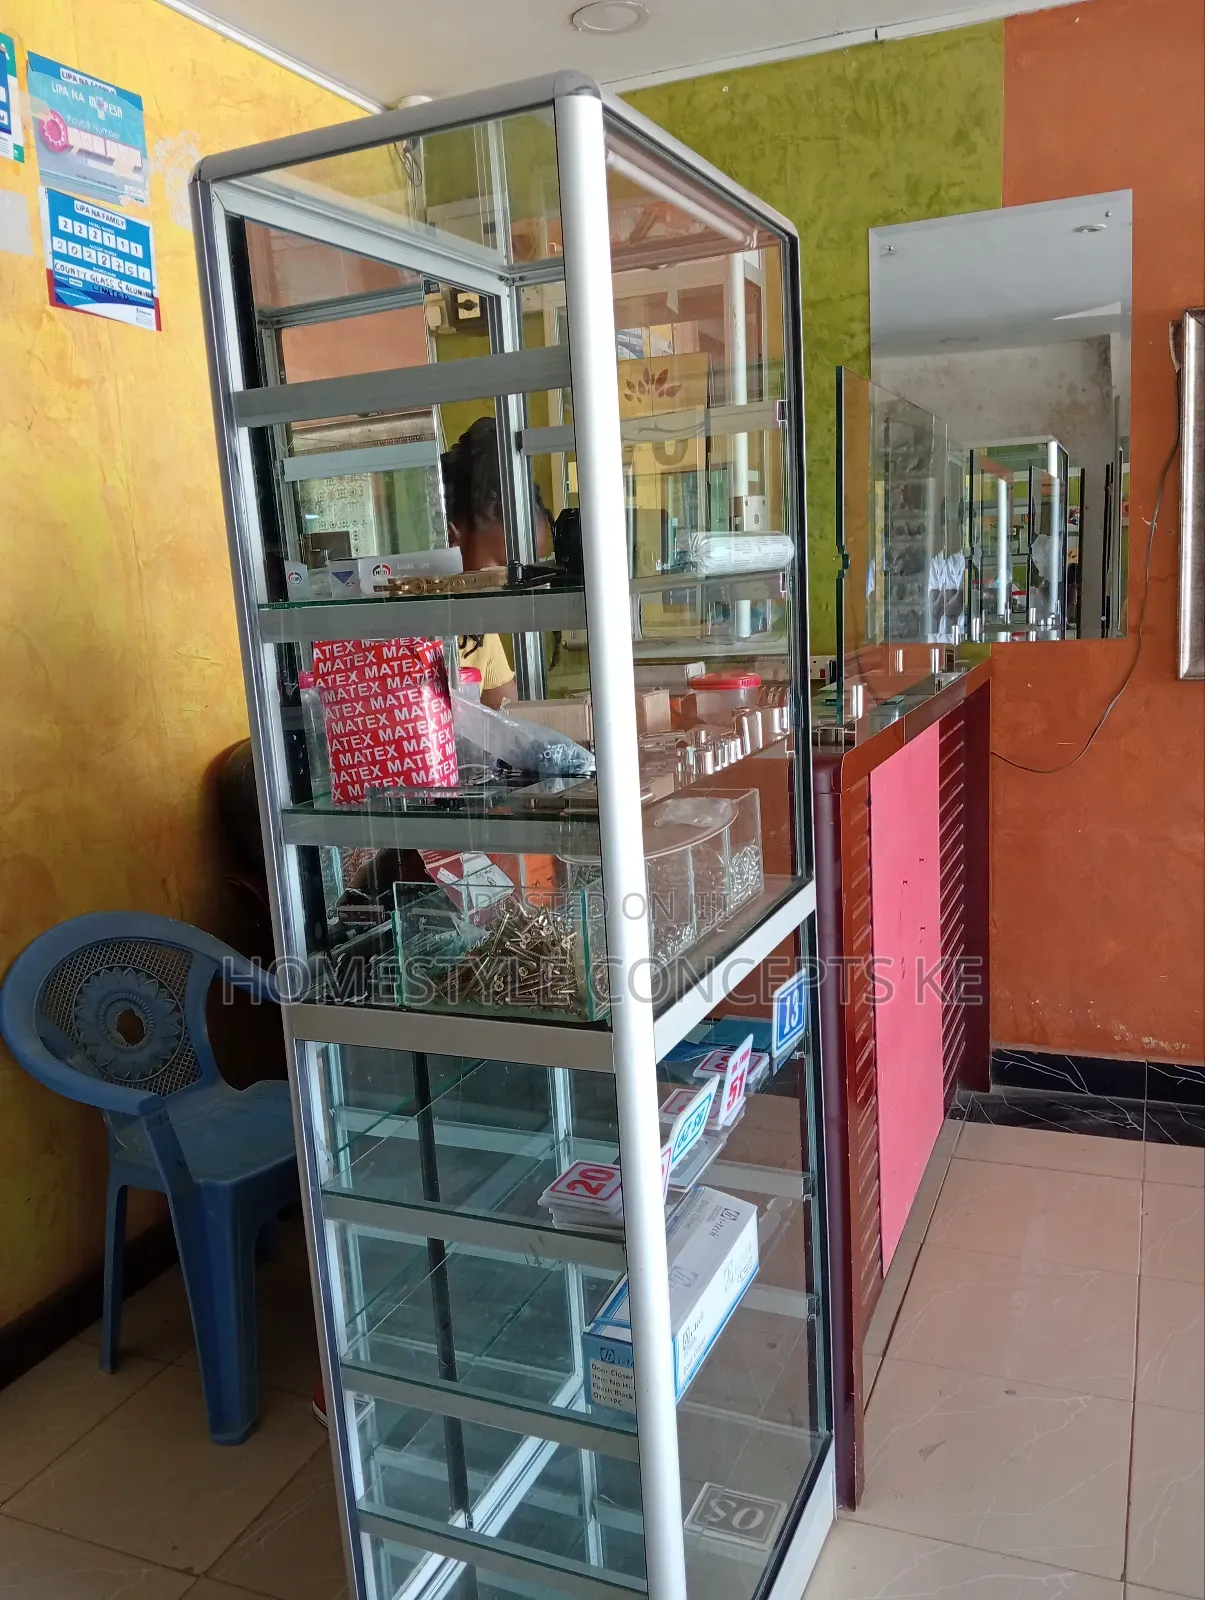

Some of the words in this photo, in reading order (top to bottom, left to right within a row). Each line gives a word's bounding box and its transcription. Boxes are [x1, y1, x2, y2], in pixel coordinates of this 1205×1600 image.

[52, 81, 68, 97] LIPA
[71, 90, 85, 104] NA
[76, 203, 90, 214] LIPA
[91, 208, 100, 218] NA
[102, 212, 125, 228] FAMILY
[54, 262, 87, 280] COUNTY
[90, 274, 114, 288] GLASS
[319, 650, 376, 674] MATEX
[364, 658, 426, 680] MATEX
[324, 682, 382, 703] MATEX
[370, 686, 432, 711] MATEX
[331, 713, 390, 735] MATEX
[394, 697, 447, 722] MATEX
[378, 719, 438, 742] MATEX
[339, 744, 400, 767] MATEX
[402, 728, 451, 754] MATEX
[387, 750, 444, 774] MATEX
[412, 758, 456, 785] MATEX
[783, 988, 800, 1034] 13
[726, 1068, 746, 1112] 51
[566, 1168, 615, 1196] 20
[592, 1363, 608, 1375] Door
[610, 1369, 634, 1380] Closer
